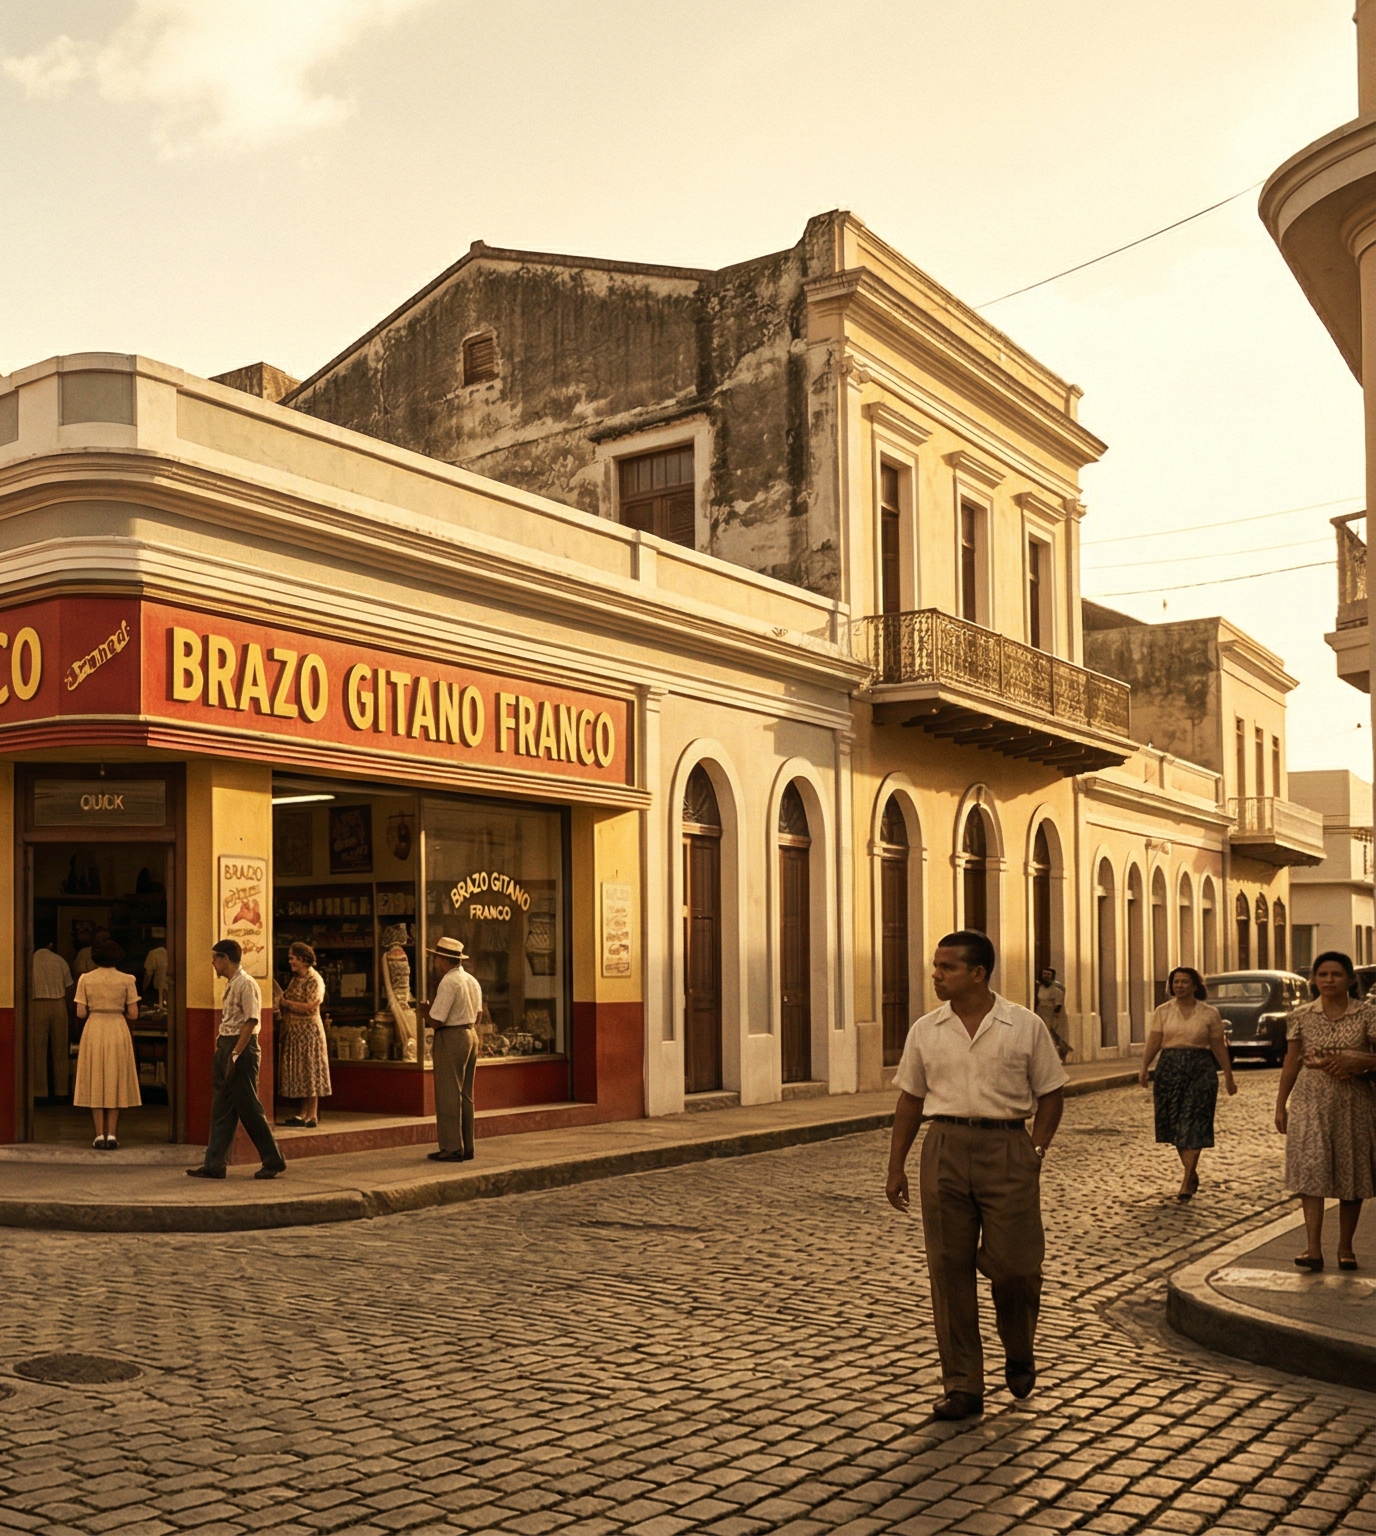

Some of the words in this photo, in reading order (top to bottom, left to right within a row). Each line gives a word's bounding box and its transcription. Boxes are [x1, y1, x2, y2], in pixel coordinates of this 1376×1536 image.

[170, 626, 329, 723] BRAZO
[345, 662, 485, 748] GITANO
[497, 691, 616, 768] FRANCO
[450, 871, 489, 909] BRAZO
[490, 871, 530, 911] GITANO
[470, 904, 511, 921] FRANCO
